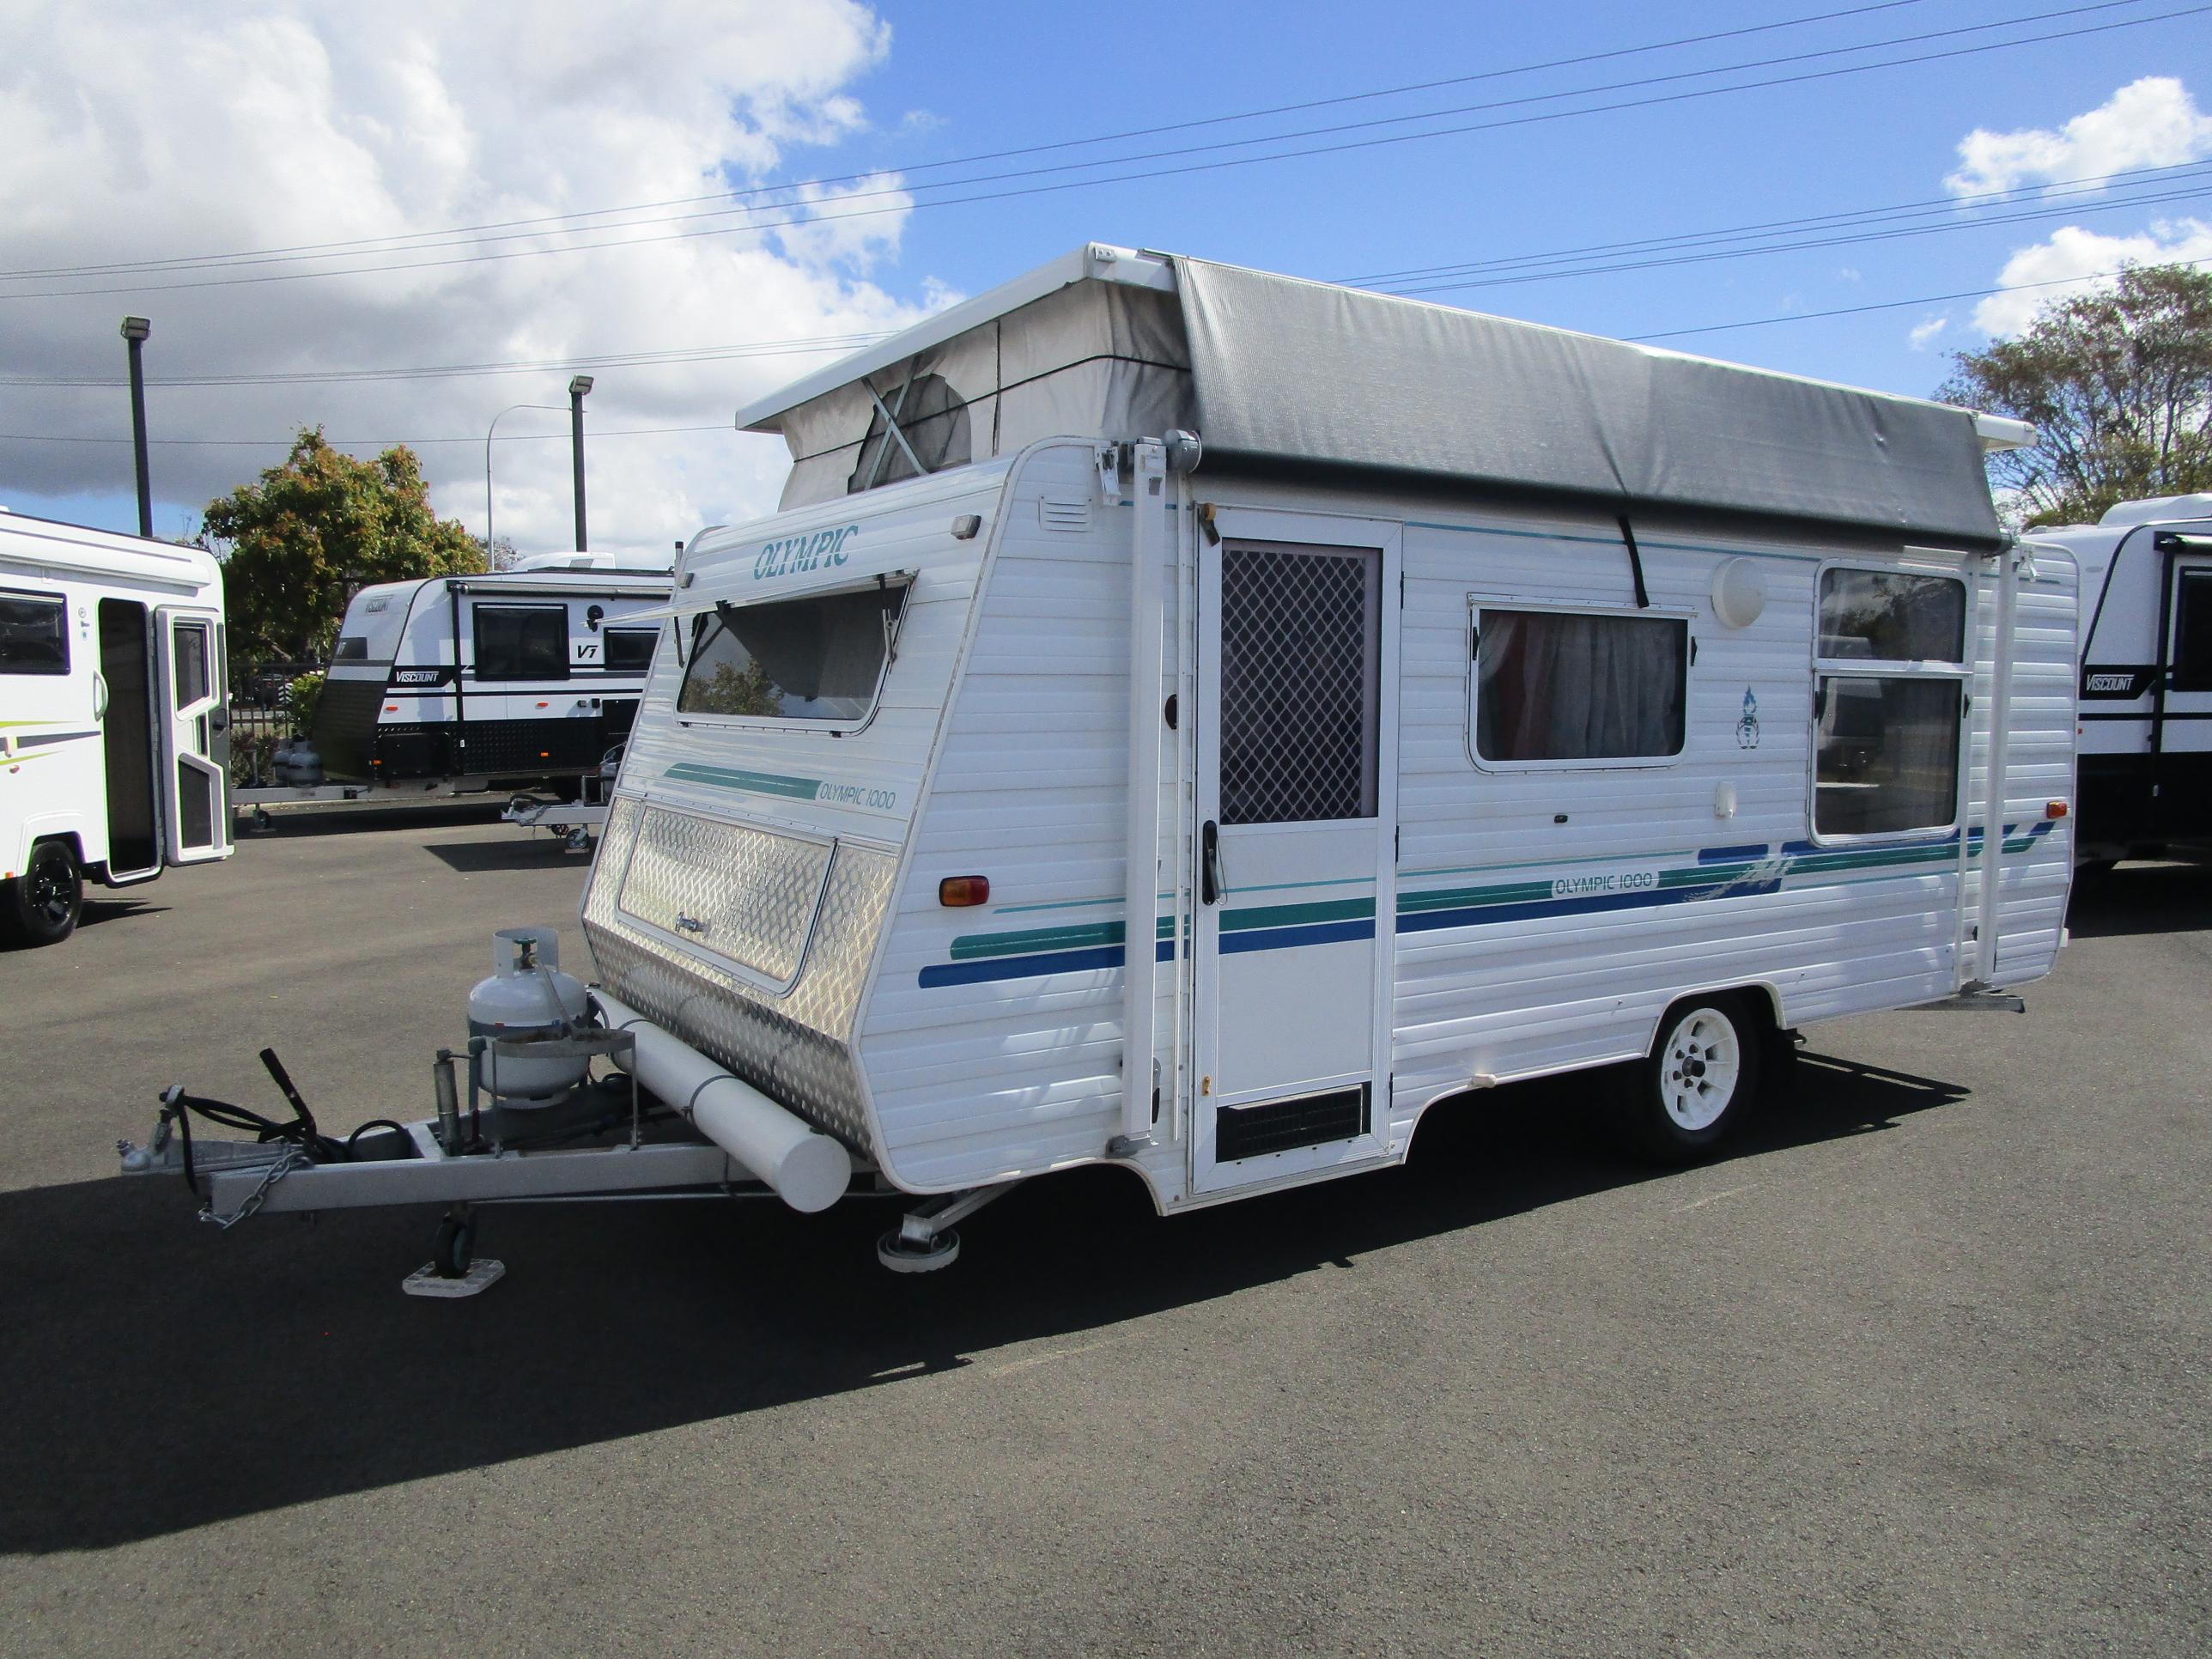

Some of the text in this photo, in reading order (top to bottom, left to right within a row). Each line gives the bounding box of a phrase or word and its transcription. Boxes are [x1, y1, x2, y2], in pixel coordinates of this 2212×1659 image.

[753, 525, 859, 580] OLYMPIC
[577, 645, 599, 659] V1
[396, 671, 440, 683] VISCOUNT
[2086, 674, 2136, 691] VISCOUNT
[820, 783, 896, 809] OLYMPIC 1000
[1555, 872, 1653, 895] OLYMPIC 1000
